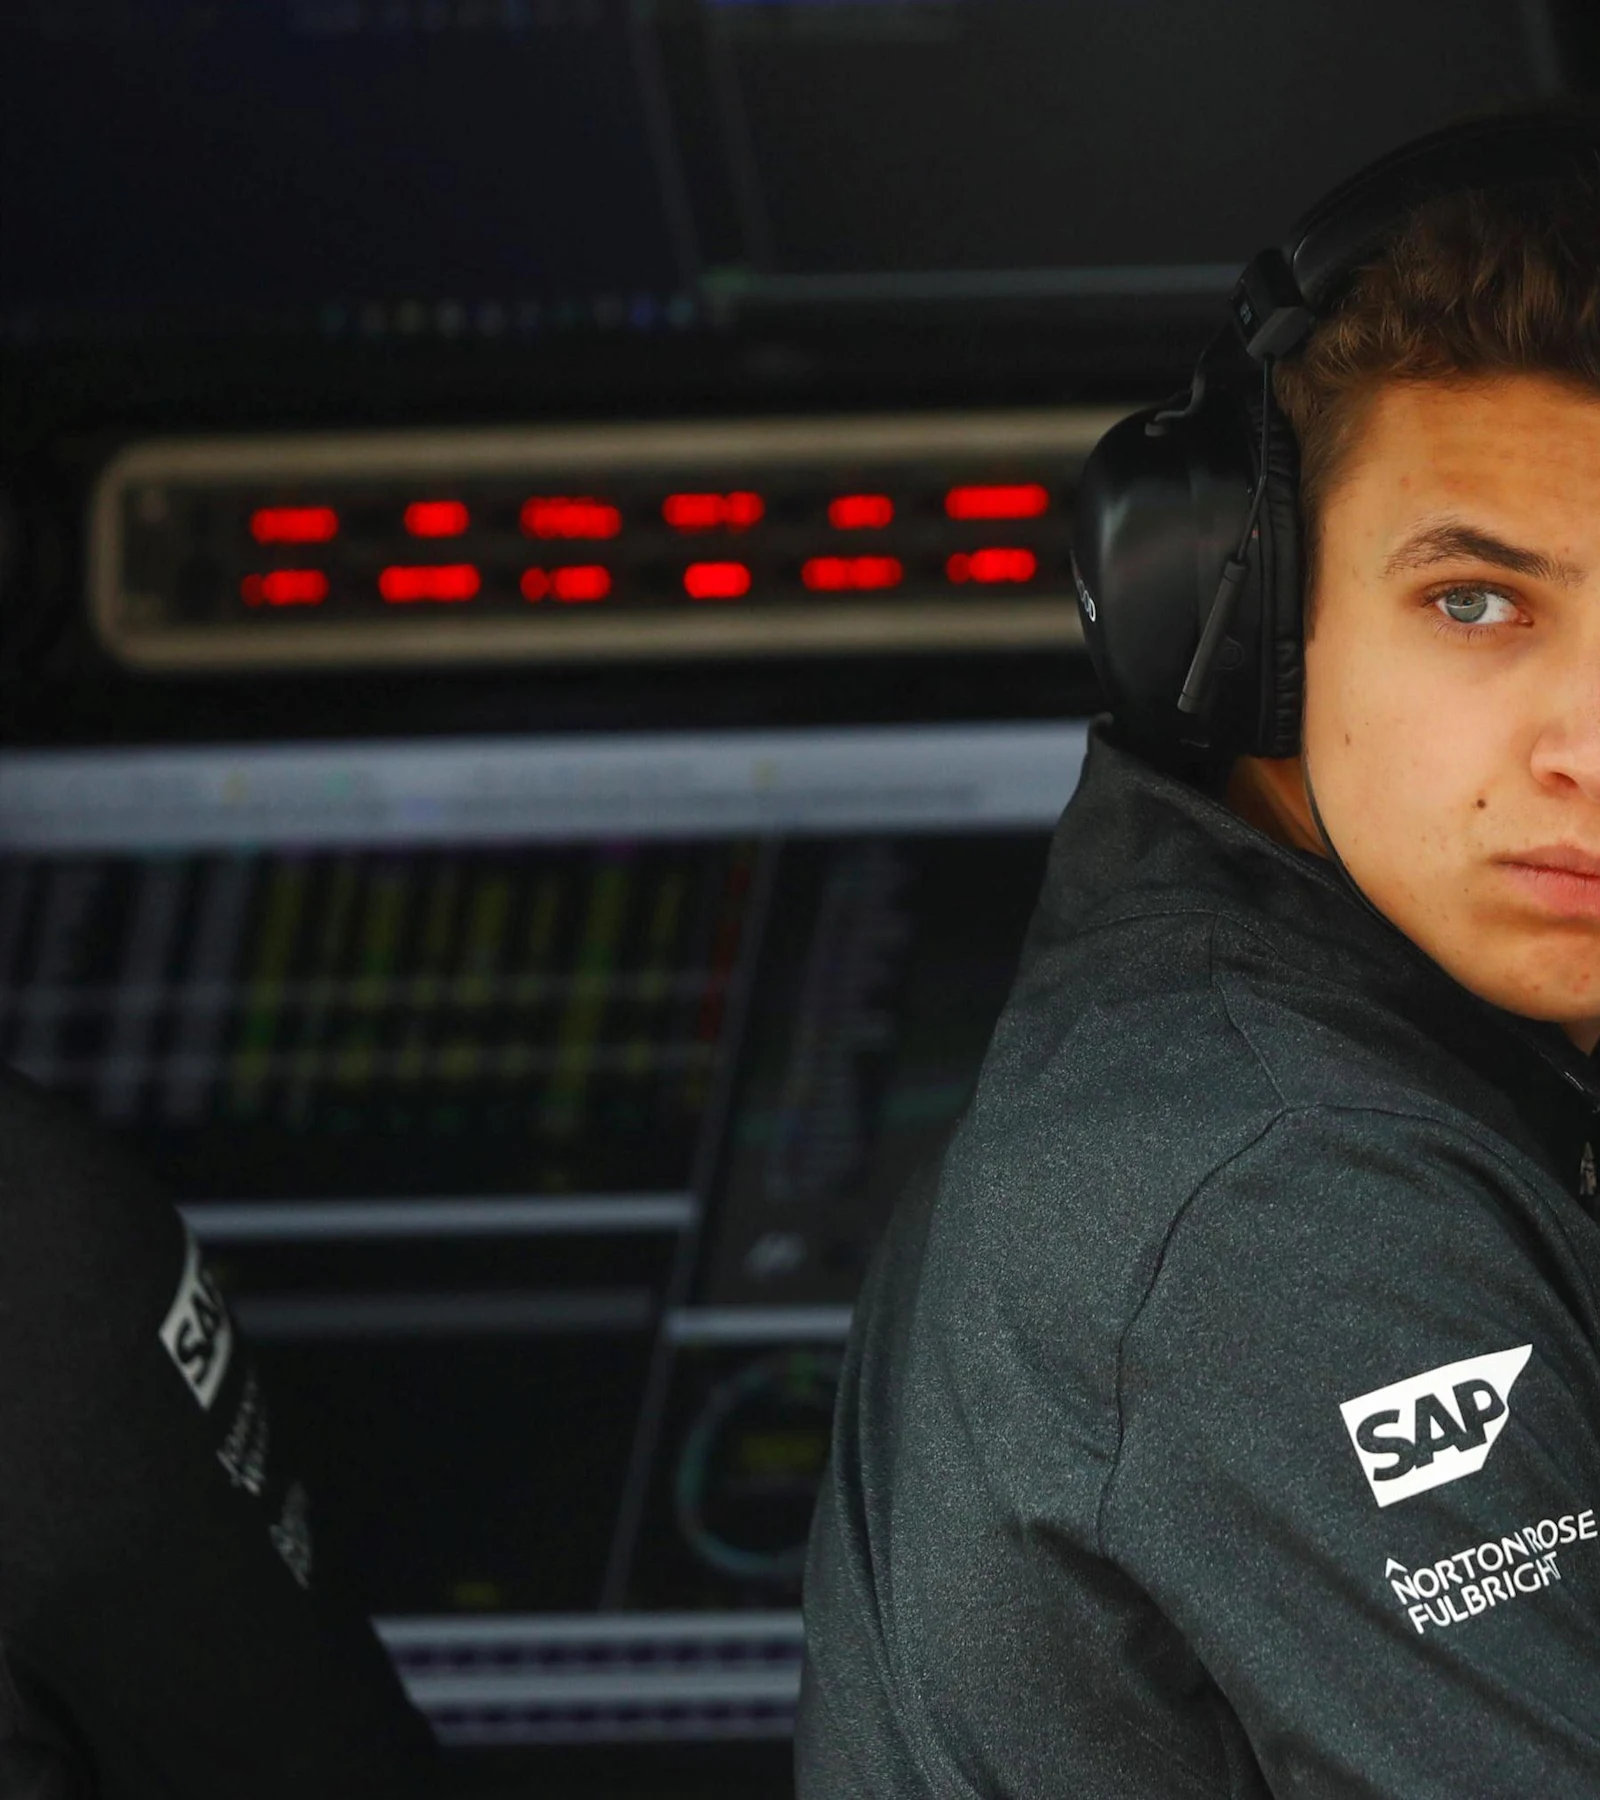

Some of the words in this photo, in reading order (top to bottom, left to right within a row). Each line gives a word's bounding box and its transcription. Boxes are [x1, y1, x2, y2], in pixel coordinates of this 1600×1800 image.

[1356, 1378, 1506, 1482] SAP
[1390, 1532, 1530, 1605] NORTON
[1522, 1509, 1598, 1553] ROSE
[1408, 1551, 1562, 1635] FULBRIGHT
